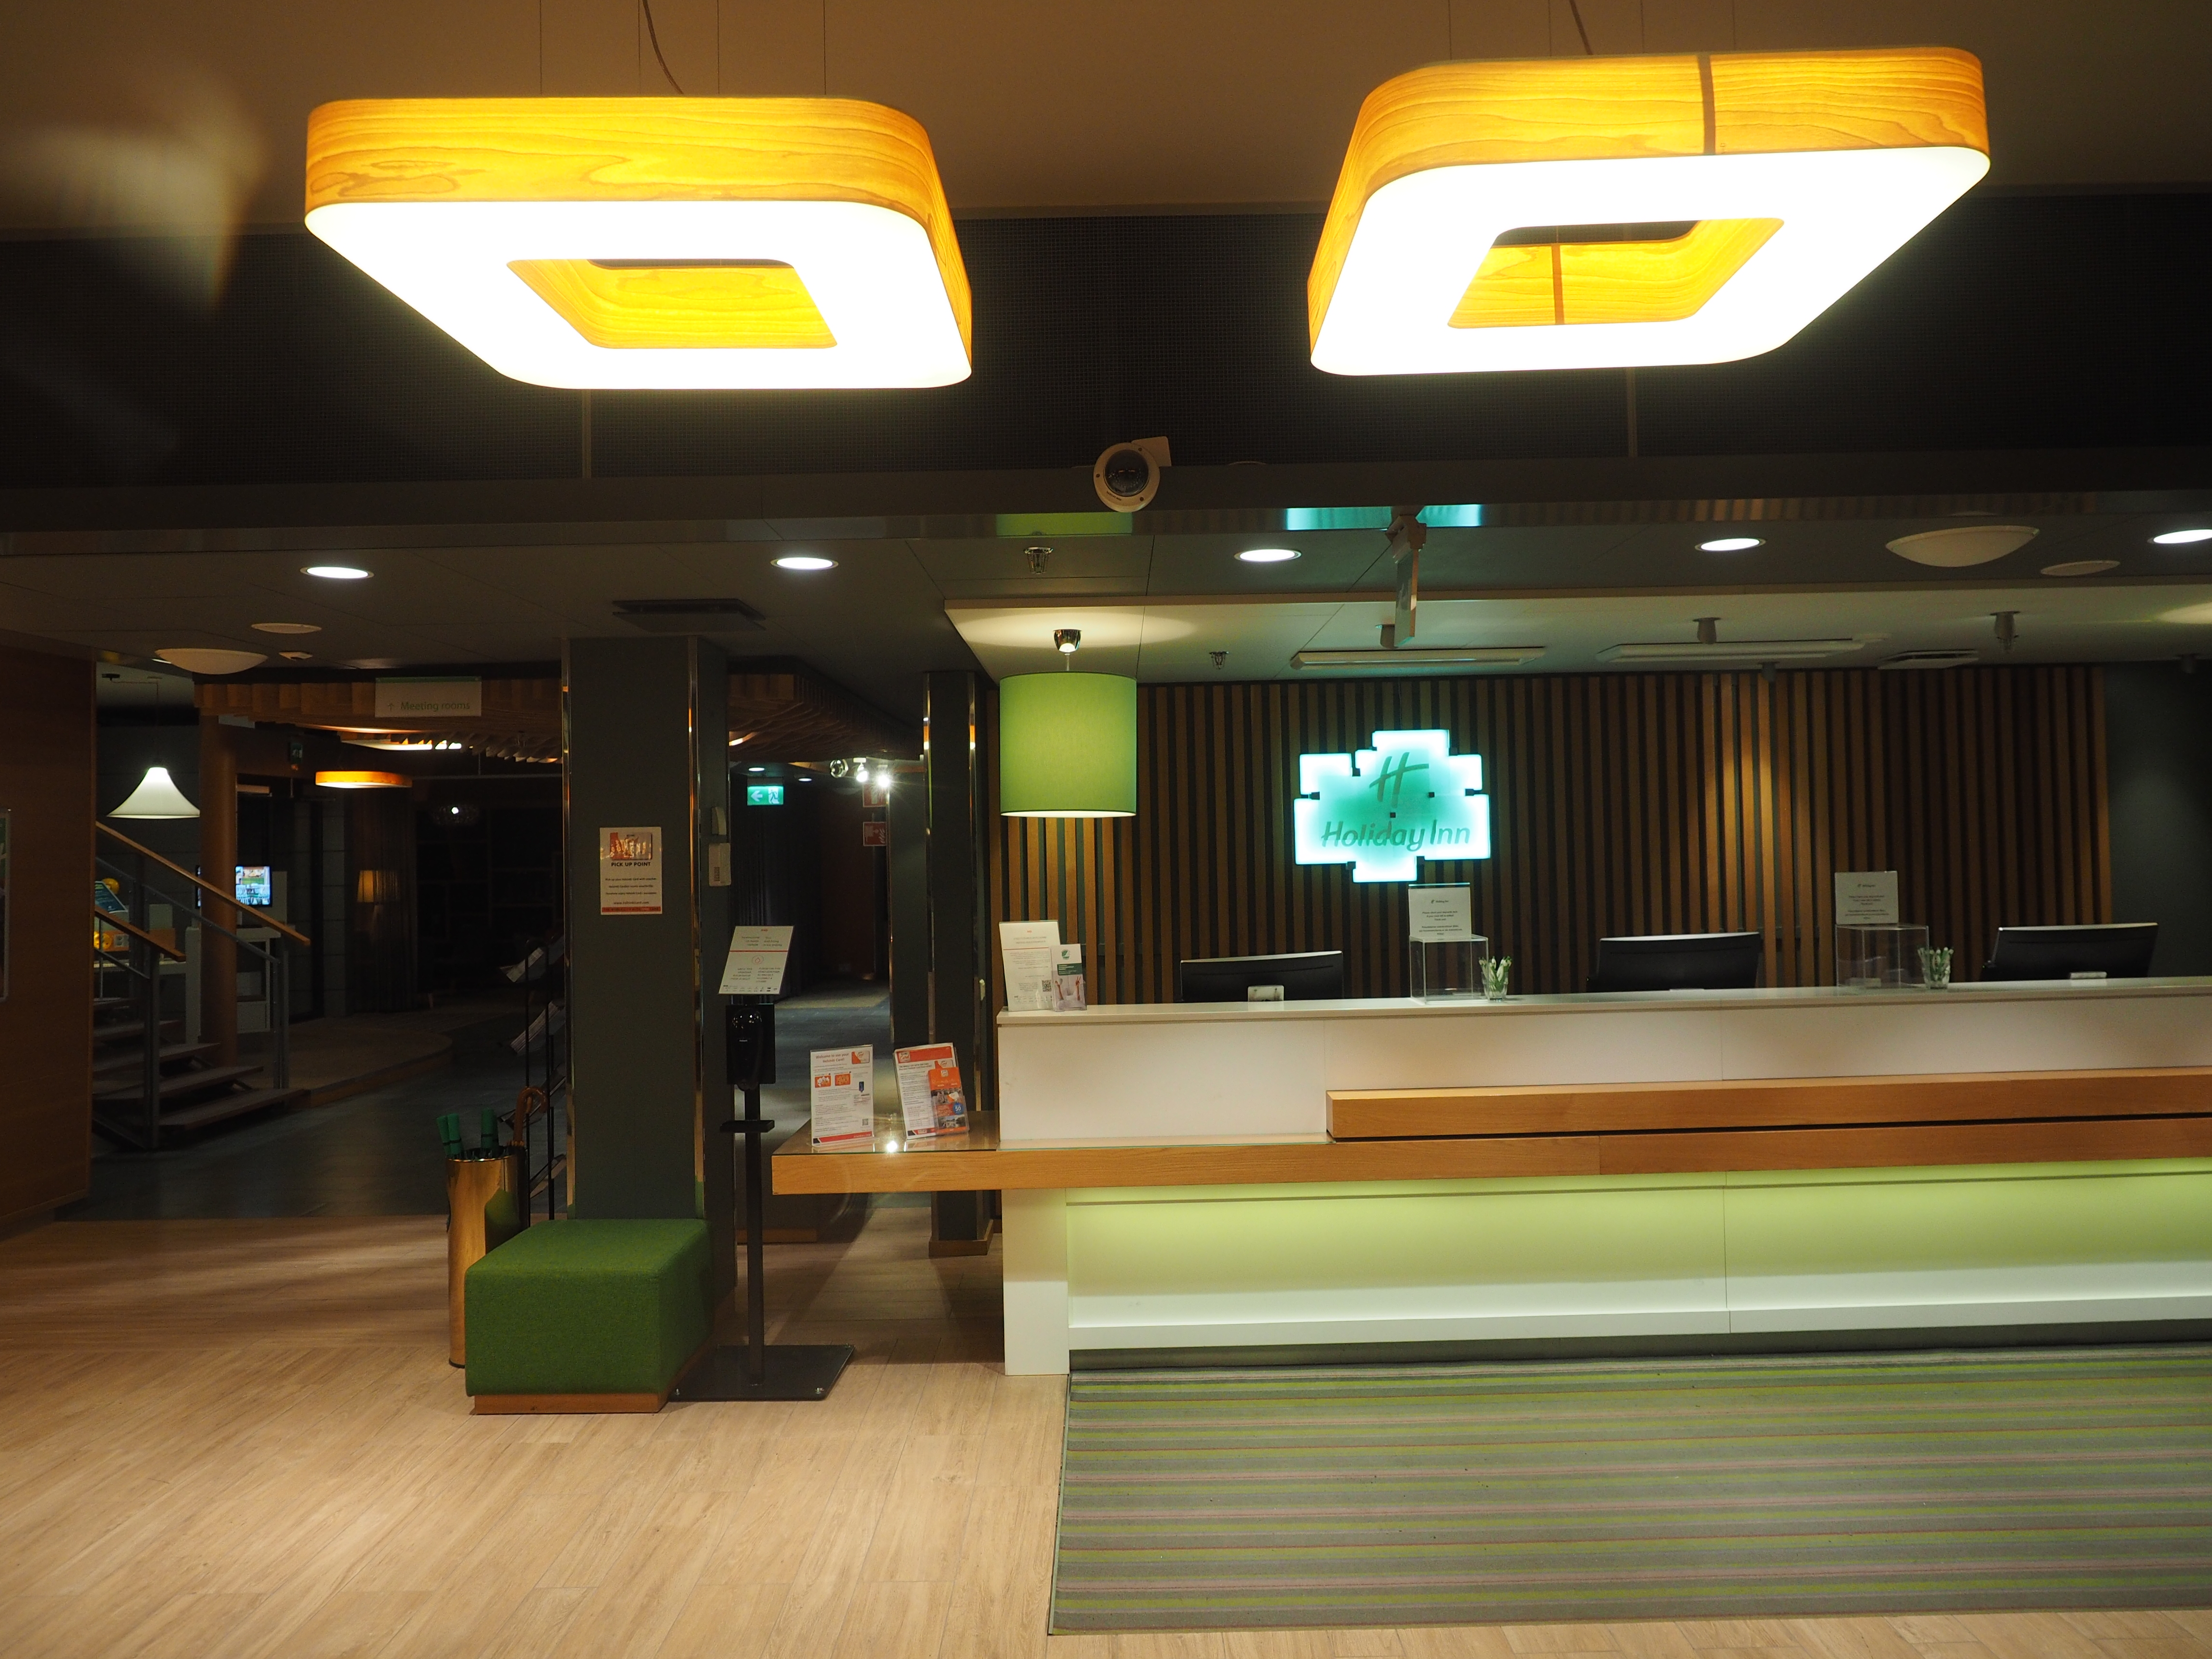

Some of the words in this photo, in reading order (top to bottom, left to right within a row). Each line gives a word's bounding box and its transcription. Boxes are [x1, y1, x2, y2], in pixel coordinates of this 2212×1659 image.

[401, 701, 439, 712] Meeting
[1321, 820, 1425, 852] Holiday
[1430, 819, 1471, 844] Inn
